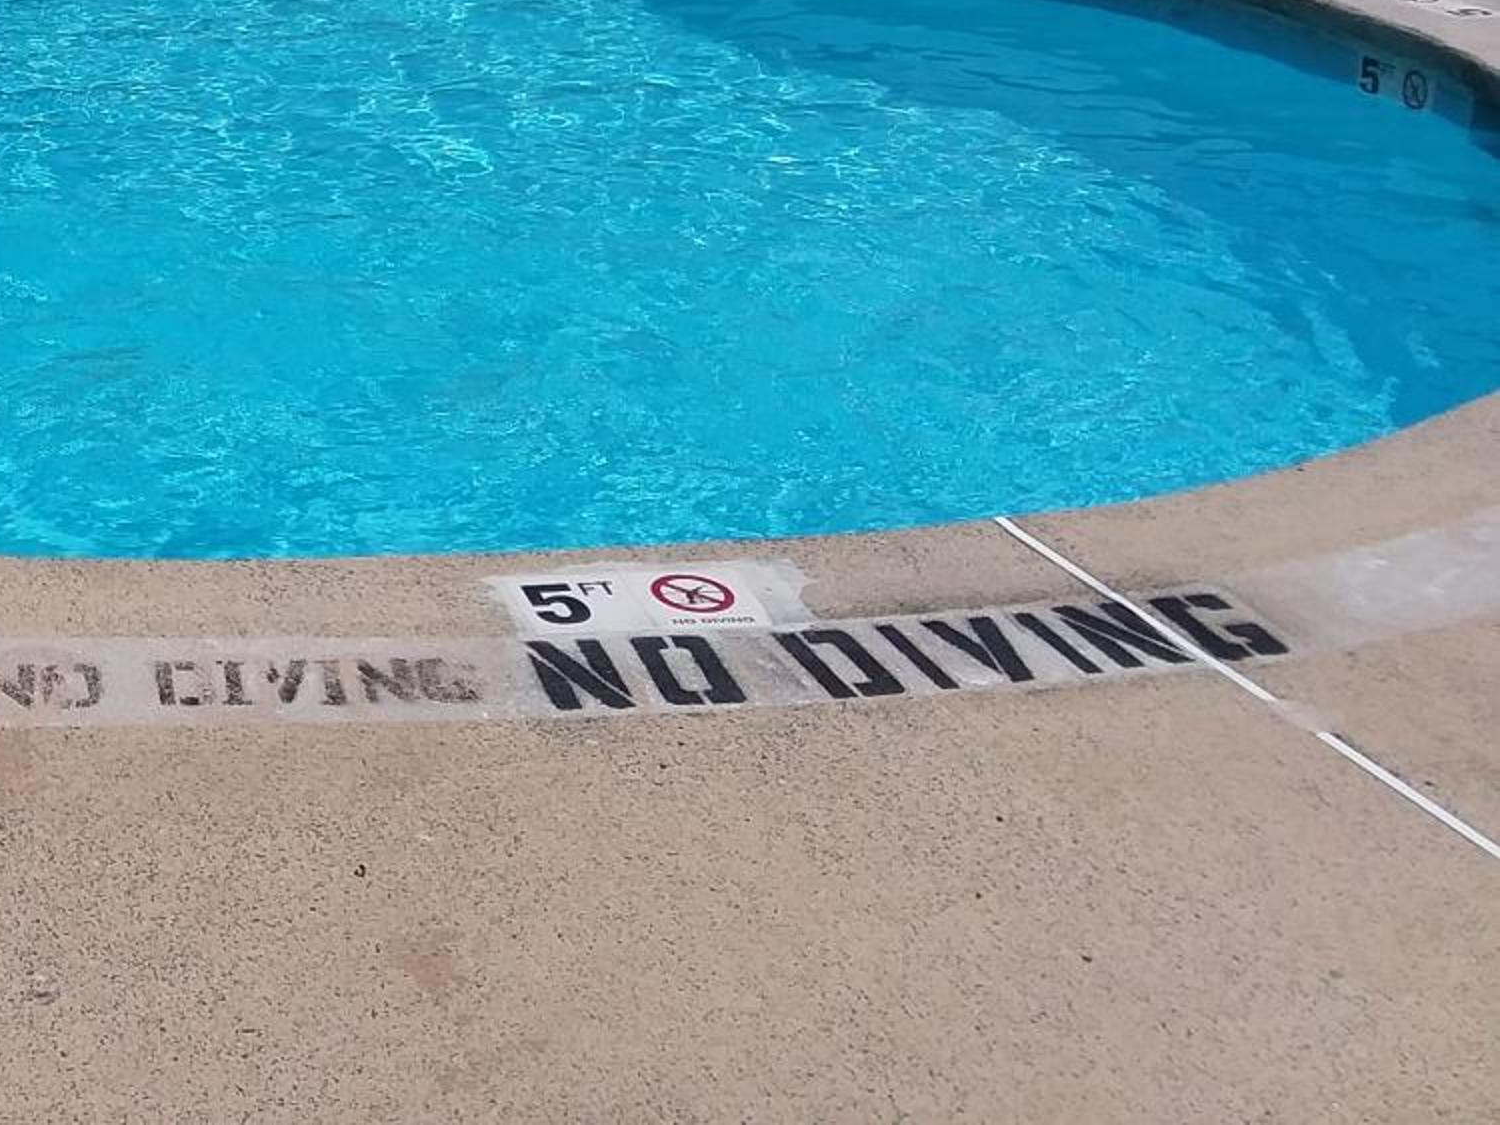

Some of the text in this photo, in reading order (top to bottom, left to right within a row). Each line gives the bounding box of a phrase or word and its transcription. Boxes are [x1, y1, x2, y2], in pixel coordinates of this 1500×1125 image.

[520, 581, 614, 625] 5 FT
[524, 592, 1291, 711] NO DIVING
